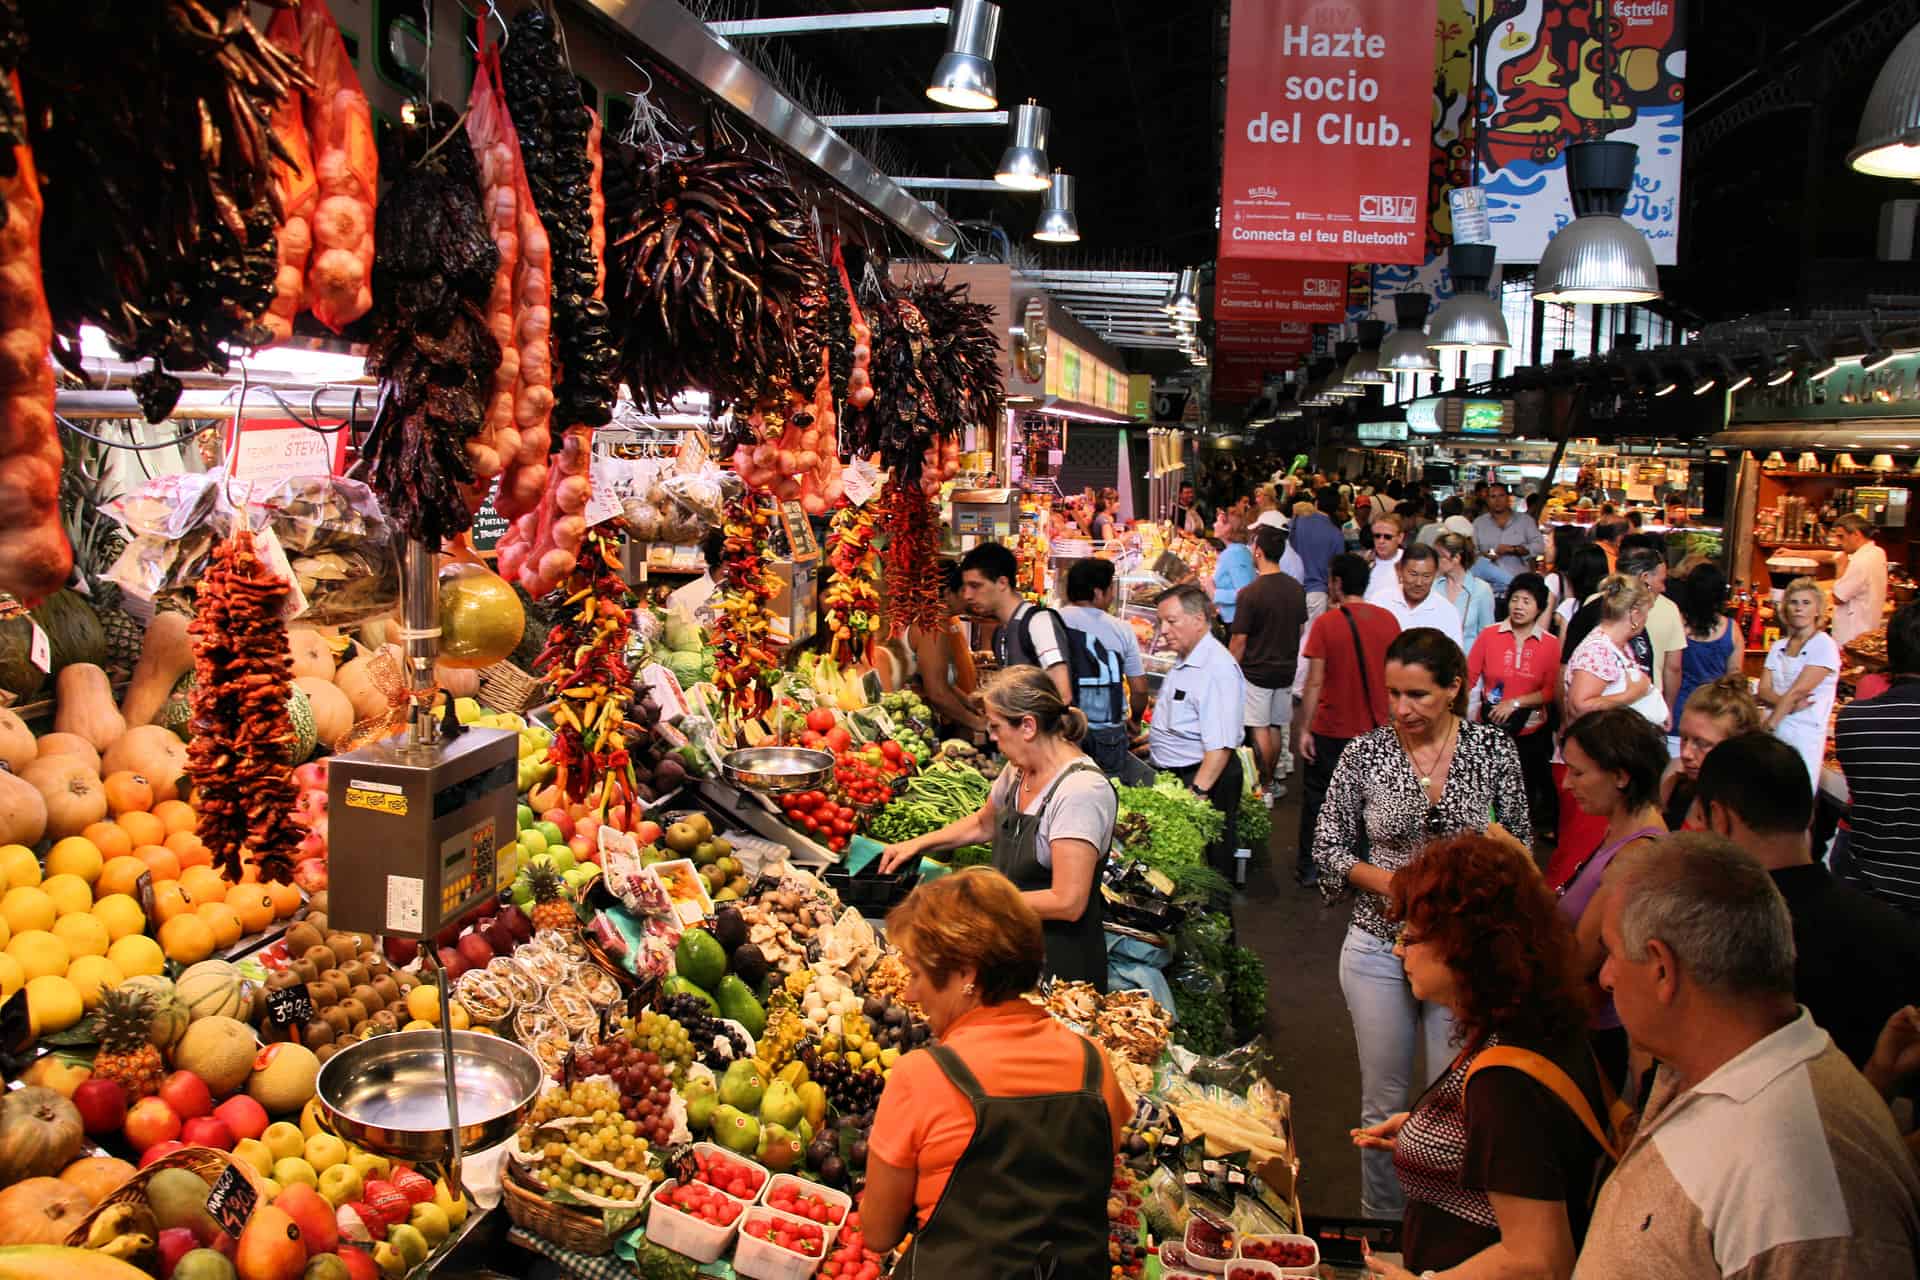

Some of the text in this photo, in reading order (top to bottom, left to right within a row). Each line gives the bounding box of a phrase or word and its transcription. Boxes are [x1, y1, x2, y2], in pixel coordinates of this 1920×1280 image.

[1614, 1, 1668, 17] Estrella
[1283, 24, 1386, 58] Hazte
[1285, 70, 1379, 102] socio
[1247, 111, 1412, 147] del Club.
[1232, 227, 1296, 241] Connecta
[1300, 229, 1312, 242] el
[1316, 230, 1338, 243] teu
[207, 1170, 234, 1214] MANGO
